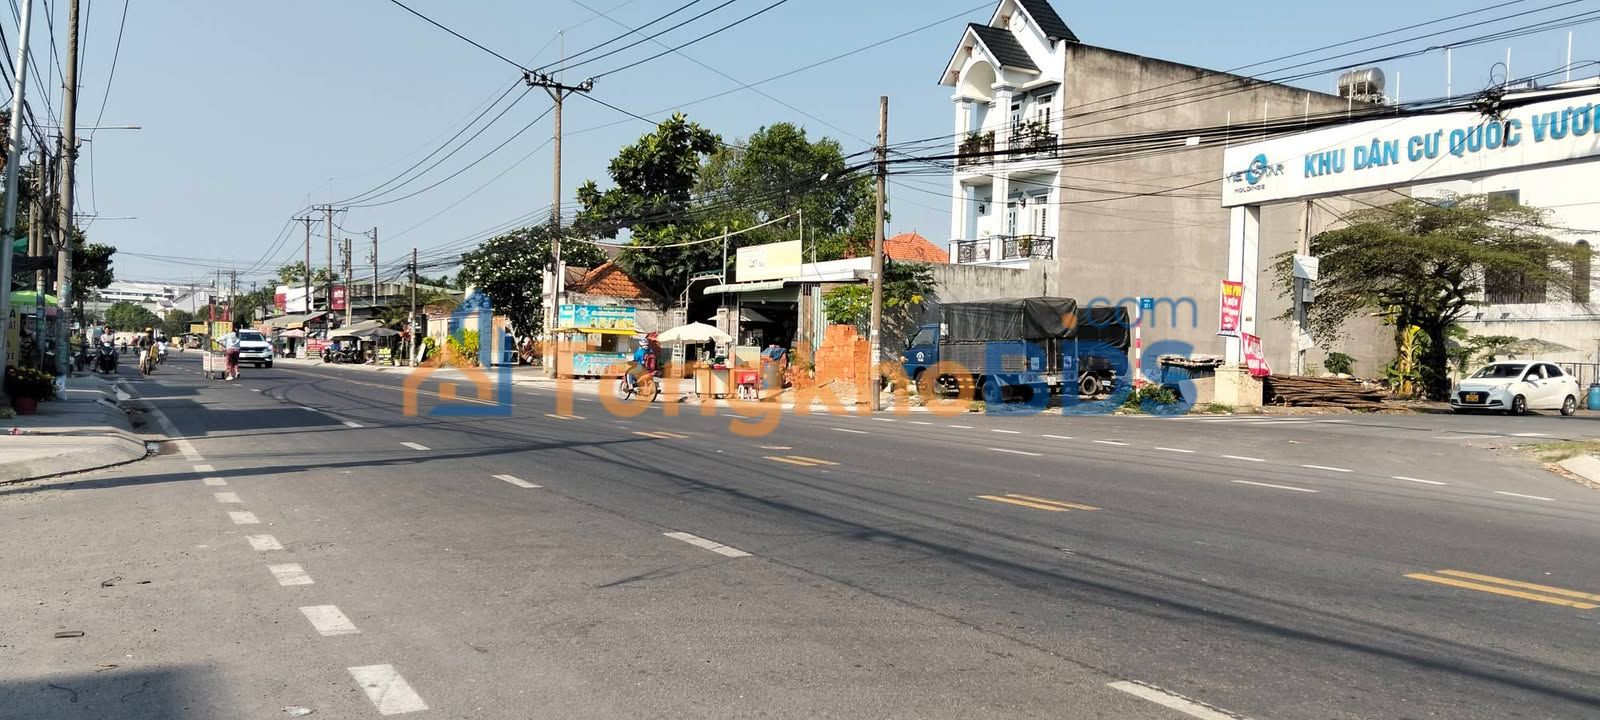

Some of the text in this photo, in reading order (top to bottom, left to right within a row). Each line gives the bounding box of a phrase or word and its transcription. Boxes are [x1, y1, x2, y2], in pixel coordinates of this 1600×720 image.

[1304, 148, 1346, 179] KHU
[1353, 137, 1399, 171] DÂN
[1407, 128, 1444, 162] CƯ
